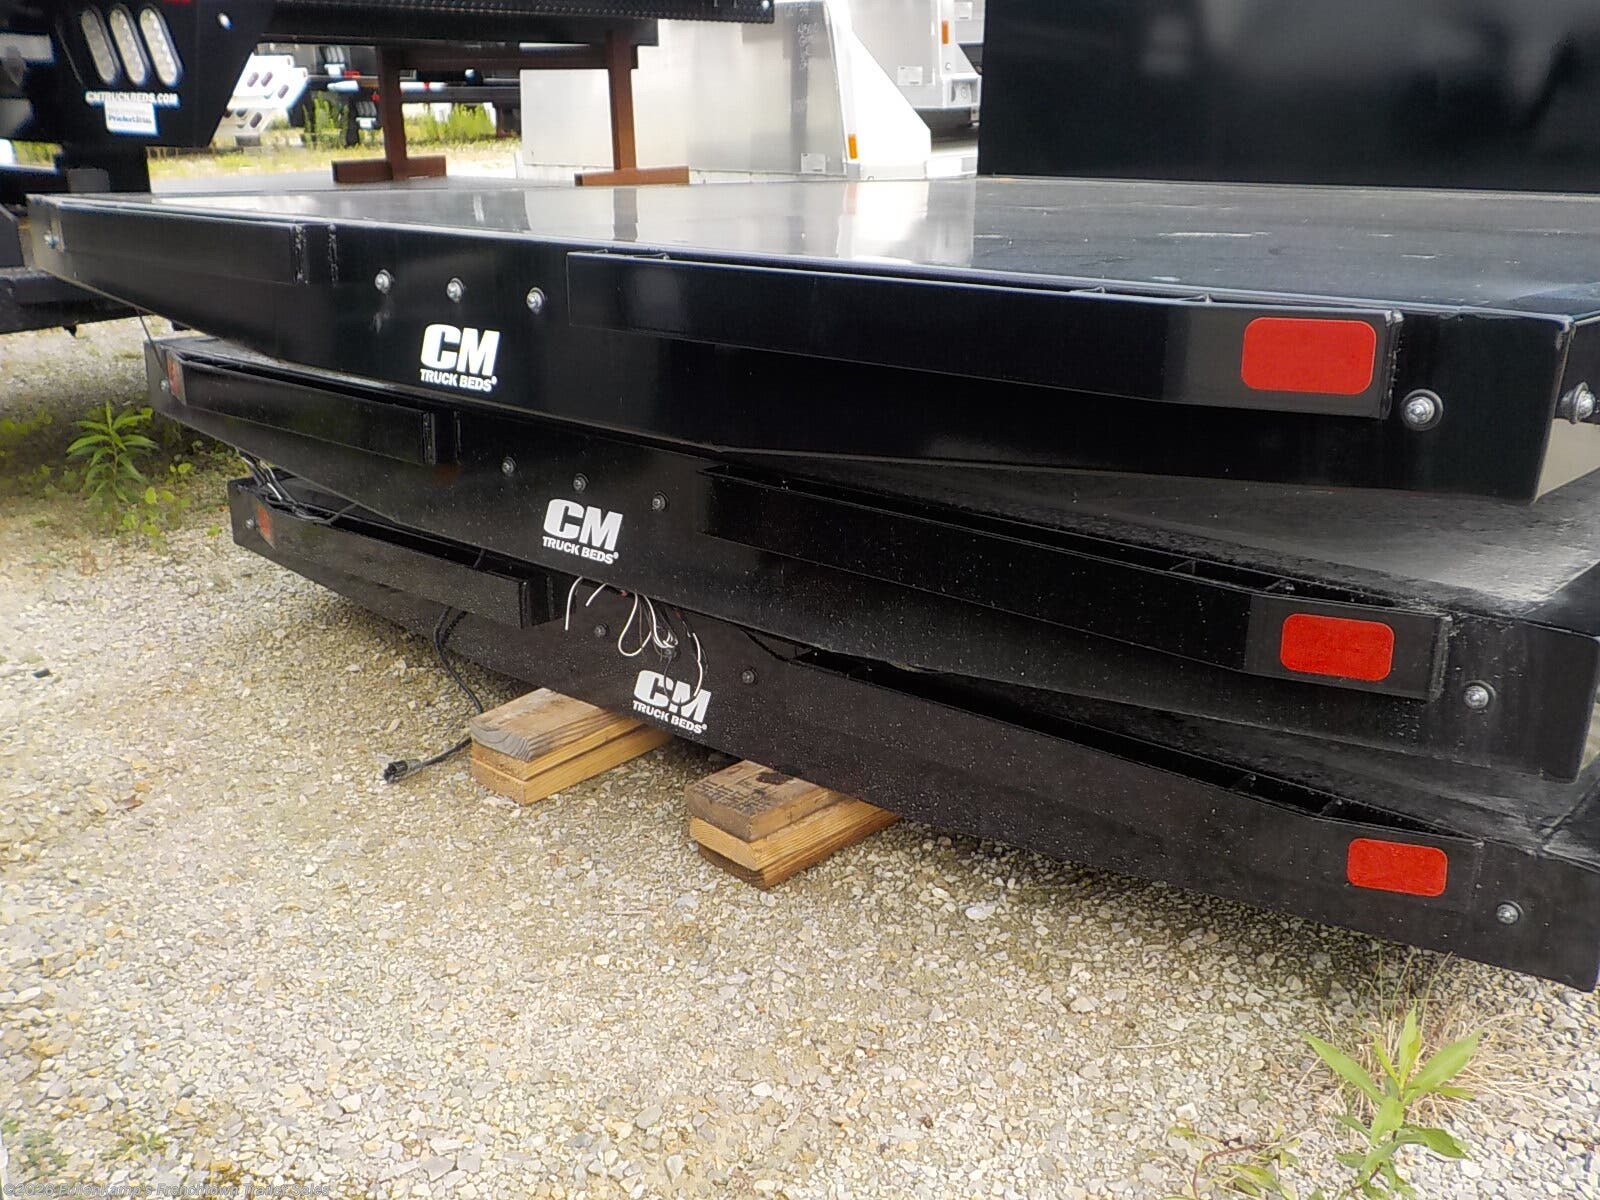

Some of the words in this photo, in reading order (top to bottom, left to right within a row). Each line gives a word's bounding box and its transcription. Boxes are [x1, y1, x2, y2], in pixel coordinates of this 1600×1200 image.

[420, 323, 500, 376] CM
[420, 368, 458, 387] TRUCK
[543, 498, 623, 551] CM
[542, 536, 580, 556] TRUCK
[632, 700, 670, 722] TRUCK
[633, 670, 711, 723] CM
